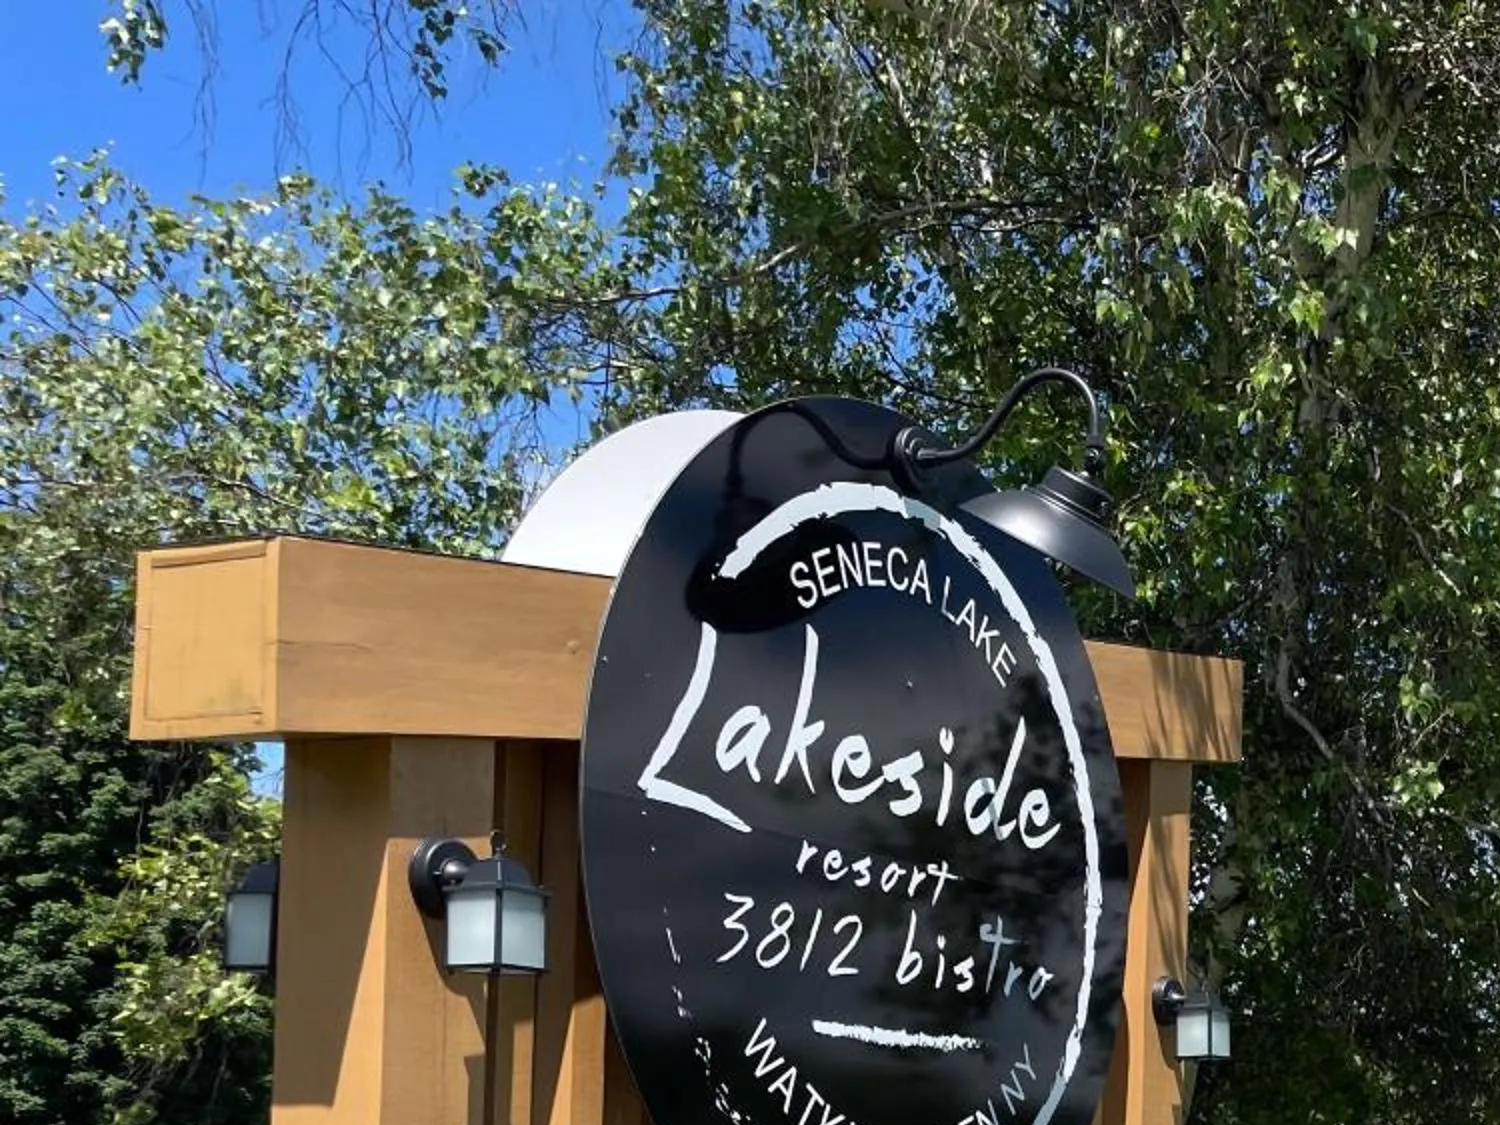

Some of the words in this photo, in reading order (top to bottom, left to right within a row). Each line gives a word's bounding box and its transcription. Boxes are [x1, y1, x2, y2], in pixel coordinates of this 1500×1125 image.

[790, 541, 931, 609] SENECA
[941, 577, 1017, 688] LAKE
[637, 622, 1061, 849] Lakeside
[796, 841, 960, 904] resort
[716, 893, 864, 976] 3812
[896, 911, 1055, 1000] bistro
[1001, 1044, 1036, 1116] NY
